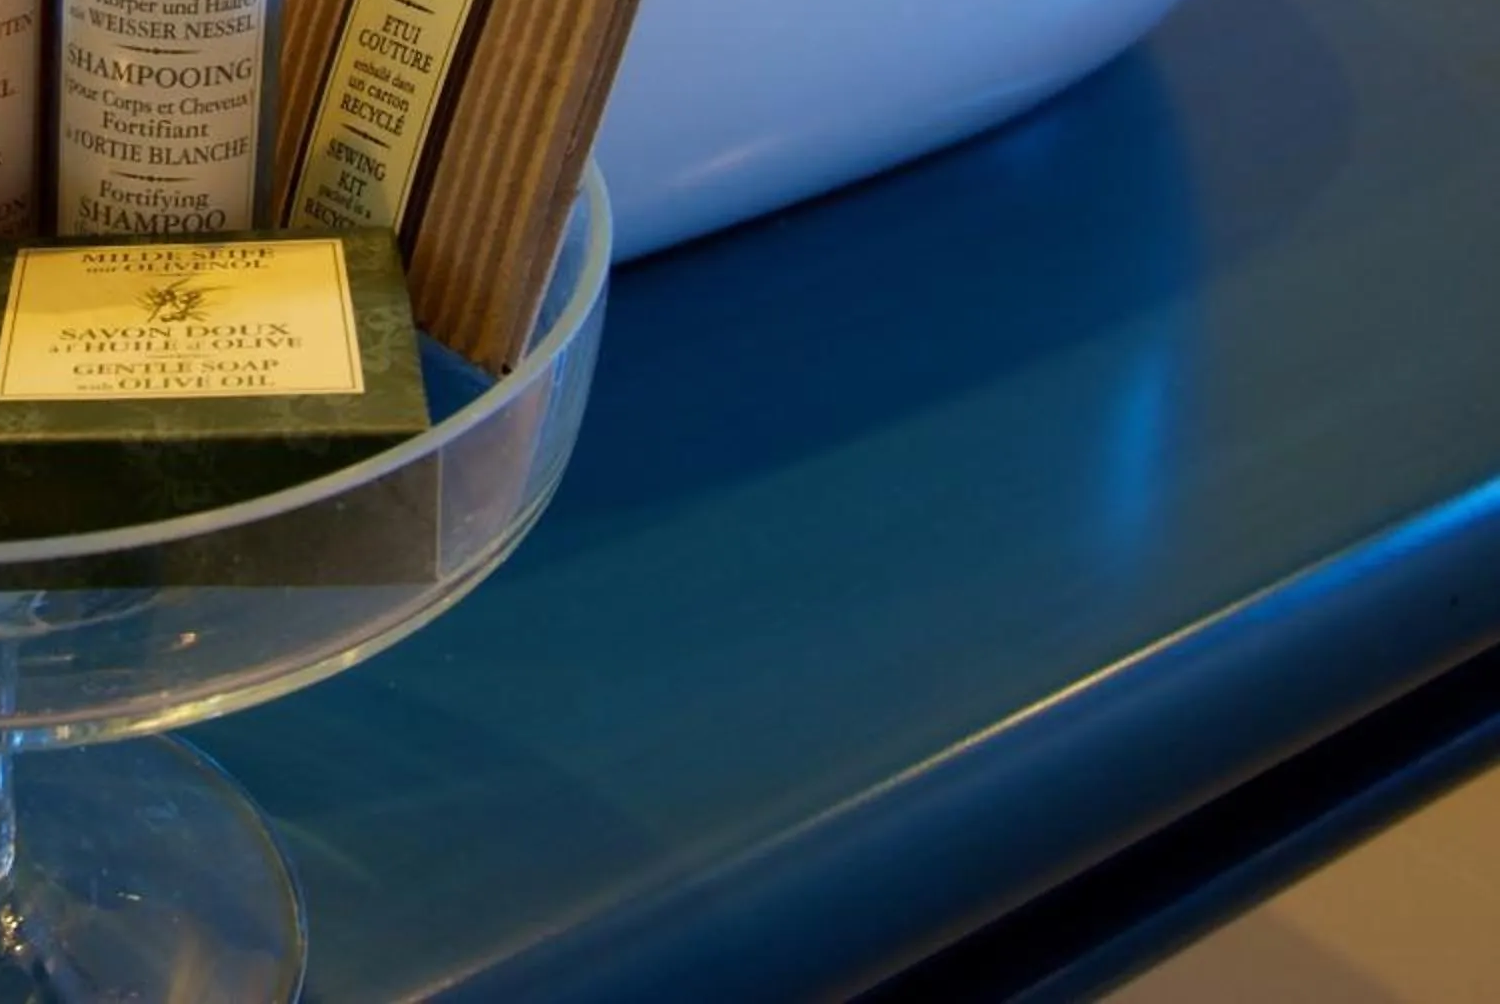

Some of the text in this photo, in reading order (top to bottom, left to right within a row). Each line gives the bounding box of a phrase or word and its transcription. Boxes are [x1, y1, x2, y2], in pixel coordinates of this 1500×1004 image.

[88, 8, 177, 39] WEISSER
[185, 14, 256, 41] NESSEL
[381, 14, 422, 45] ETUI
[67, 44, 253, 89] SHAMPOOING
[358, 28, 434, 74] COUTURE
[102, 89, 152, 117] Corps
[157, 101, 175, 115] et
[348, 75, 410, 113] un carton
[102, 111, 211, 139] Fortifiant
[340, 93, 406, 137] RECYCLÉ
[149, 136, 251, 165] BLANCHE
[326, 138, 387, 181] SEWING
[99, 179, 211, 213] Fortifying
[338, 169, 368, 197] KIT
[79, 195, 227, 234] SHAMPOO
[82, 248, 276, 264] MILDE SEIFE
[59, 323, 291, 341] SAVON DOUX
[72, 359, 280, 375] GENTLE SOAP
[118, 376, 211, 391] OLIVE
[220, 375, 278, 387] OIL
